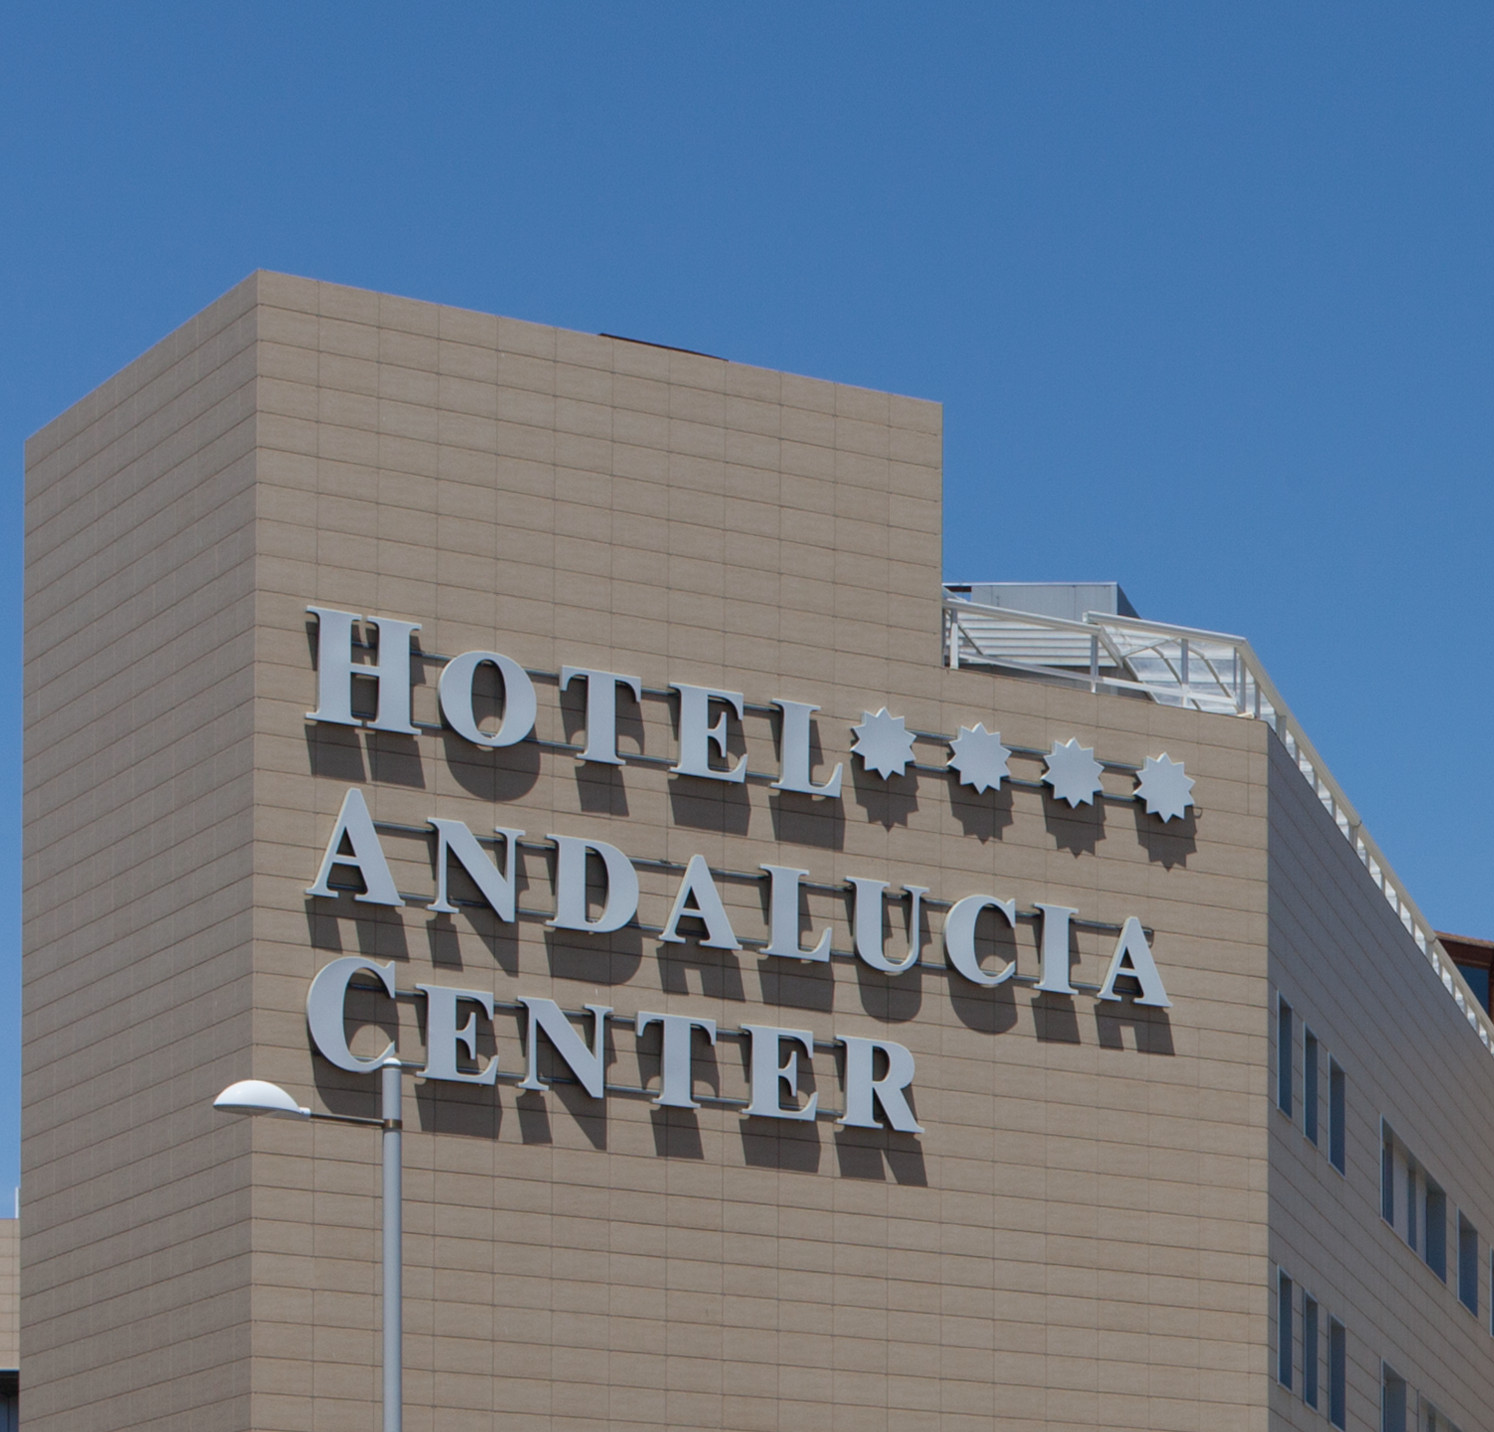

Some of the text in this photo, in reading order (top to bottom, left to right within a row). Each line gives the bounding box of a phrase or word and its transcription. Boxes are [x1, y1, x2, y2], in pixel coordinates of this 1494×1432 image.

[304, 604, 842, 798] HOTEL
[304, 787, 1174, 1008] ANDALUCIA
[306, 954, 925, 1134] CENTER
